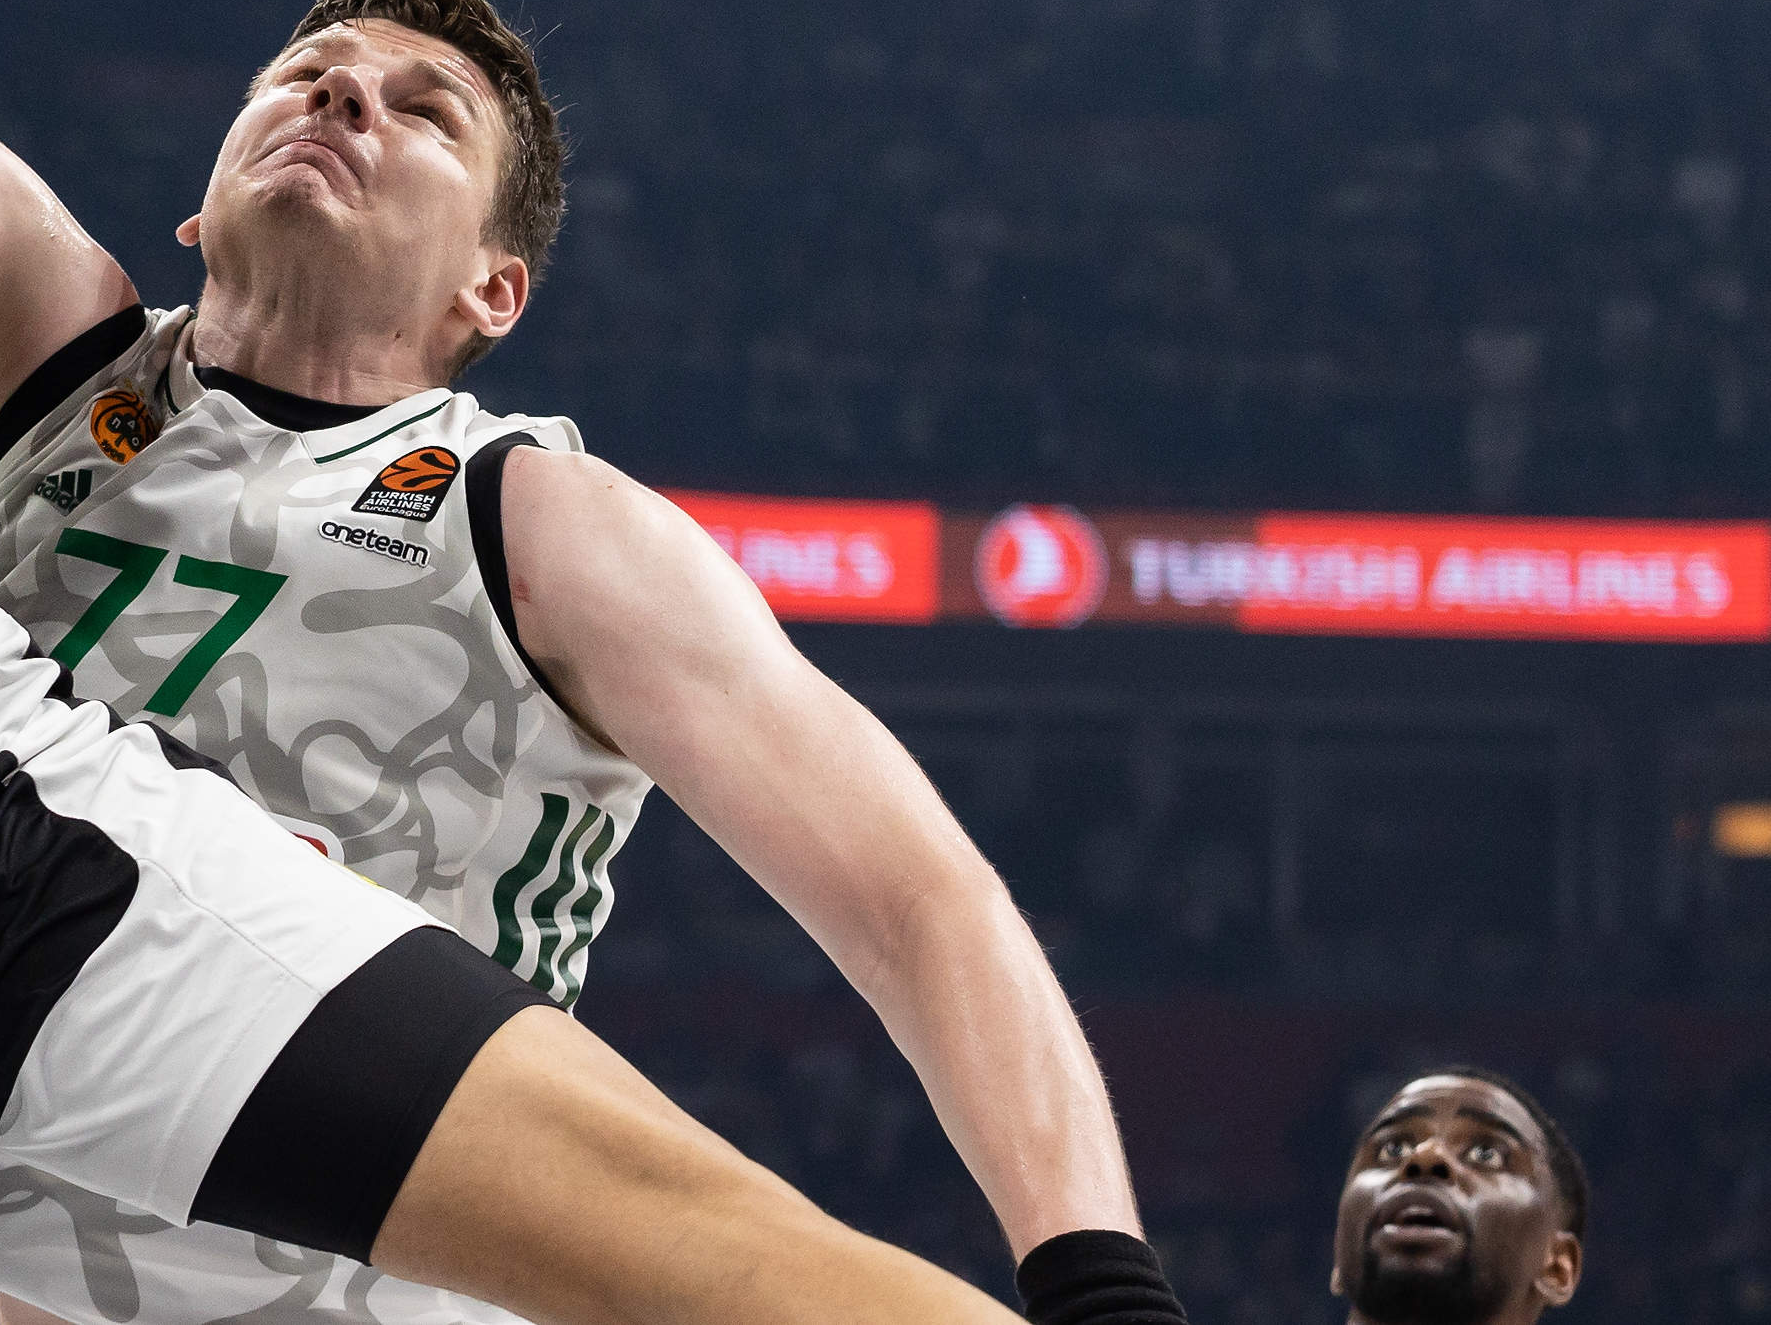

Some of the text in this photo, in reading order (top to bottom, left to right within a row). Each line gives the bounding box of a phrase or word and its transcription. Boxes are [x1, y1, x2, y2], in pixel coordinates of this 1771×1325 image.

[359, 504, 427, 519] EuroLeague
[363, 498, 432, 512] AIRLINES
[369, 490, 436, 504] TURKISH
[321, 521, 428, 565] oneteam
[1128, 538, 1732, 618] TURKISH AIRLINES
[50, 528, 289, 717] 77
